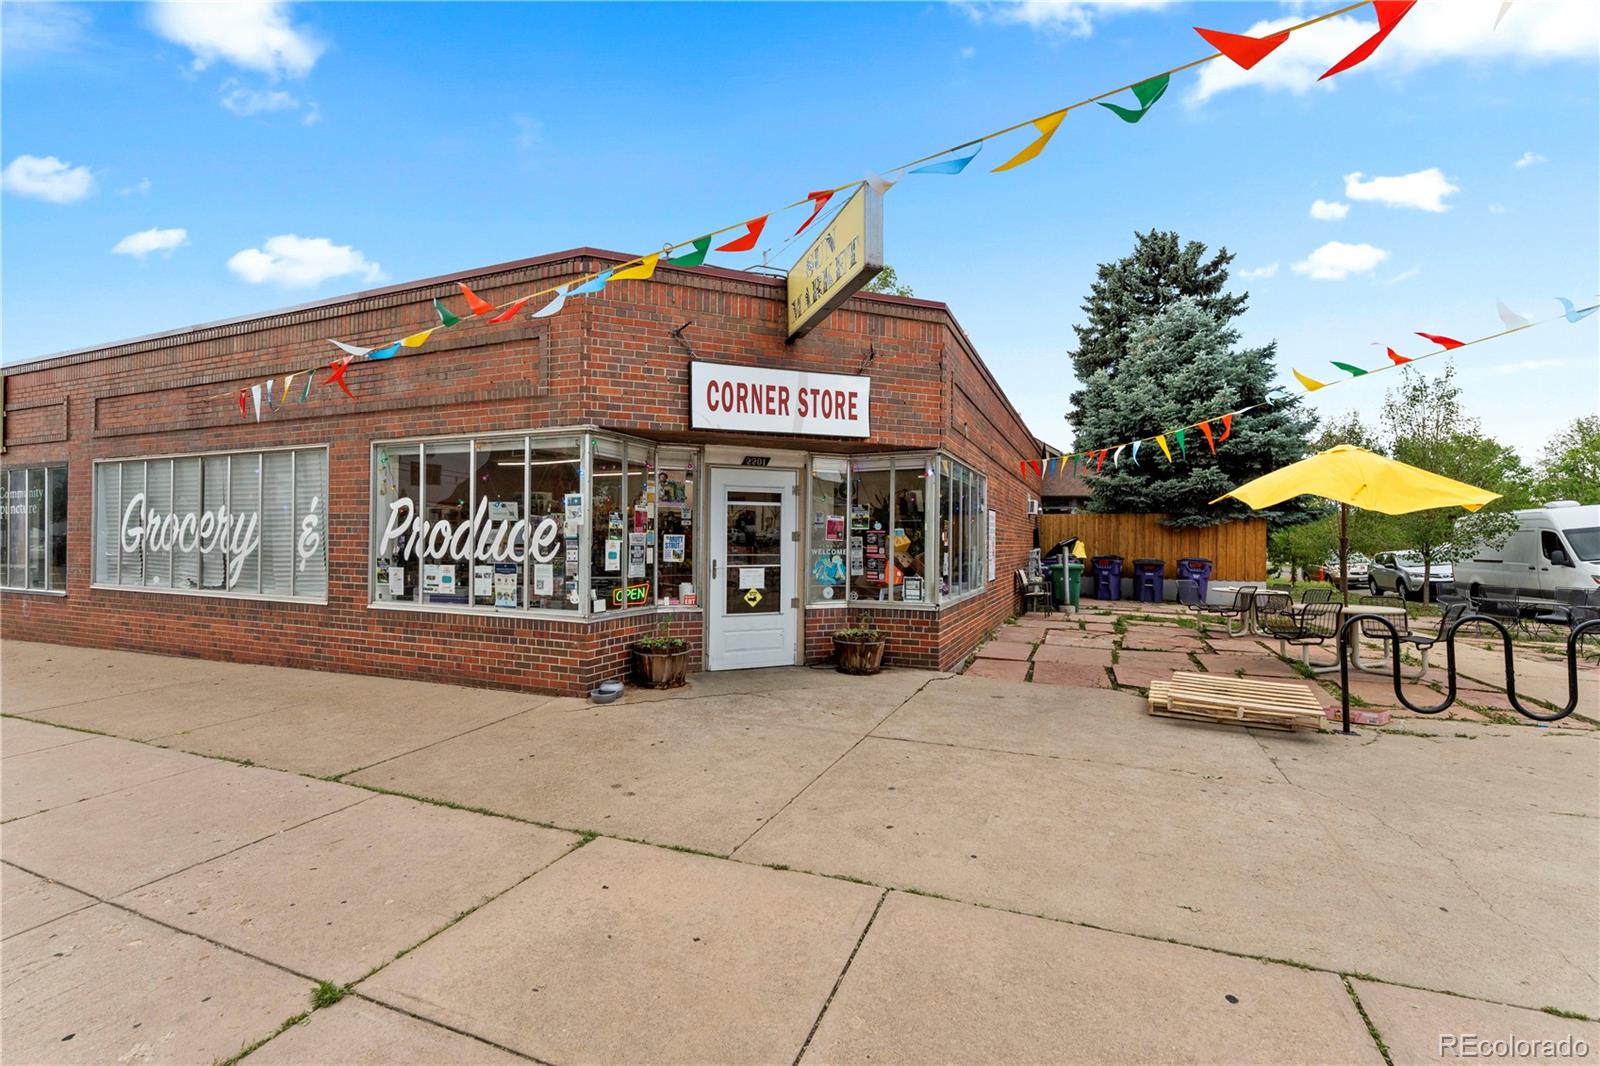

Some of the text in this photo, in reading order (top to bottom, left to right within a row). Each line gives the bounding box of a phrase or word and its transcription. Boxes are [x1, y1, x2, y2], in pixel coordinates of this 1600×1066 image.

[706, 379, 858, 421] CORNER STORE
[745, 457, 766, 466] 2201
[121, 492, 320, 588] Grocery &
[379, 495, 561, 563] Produce
[811, 548, 847, 556] WELCOME
[615, 587, 646, 602] OPEN
